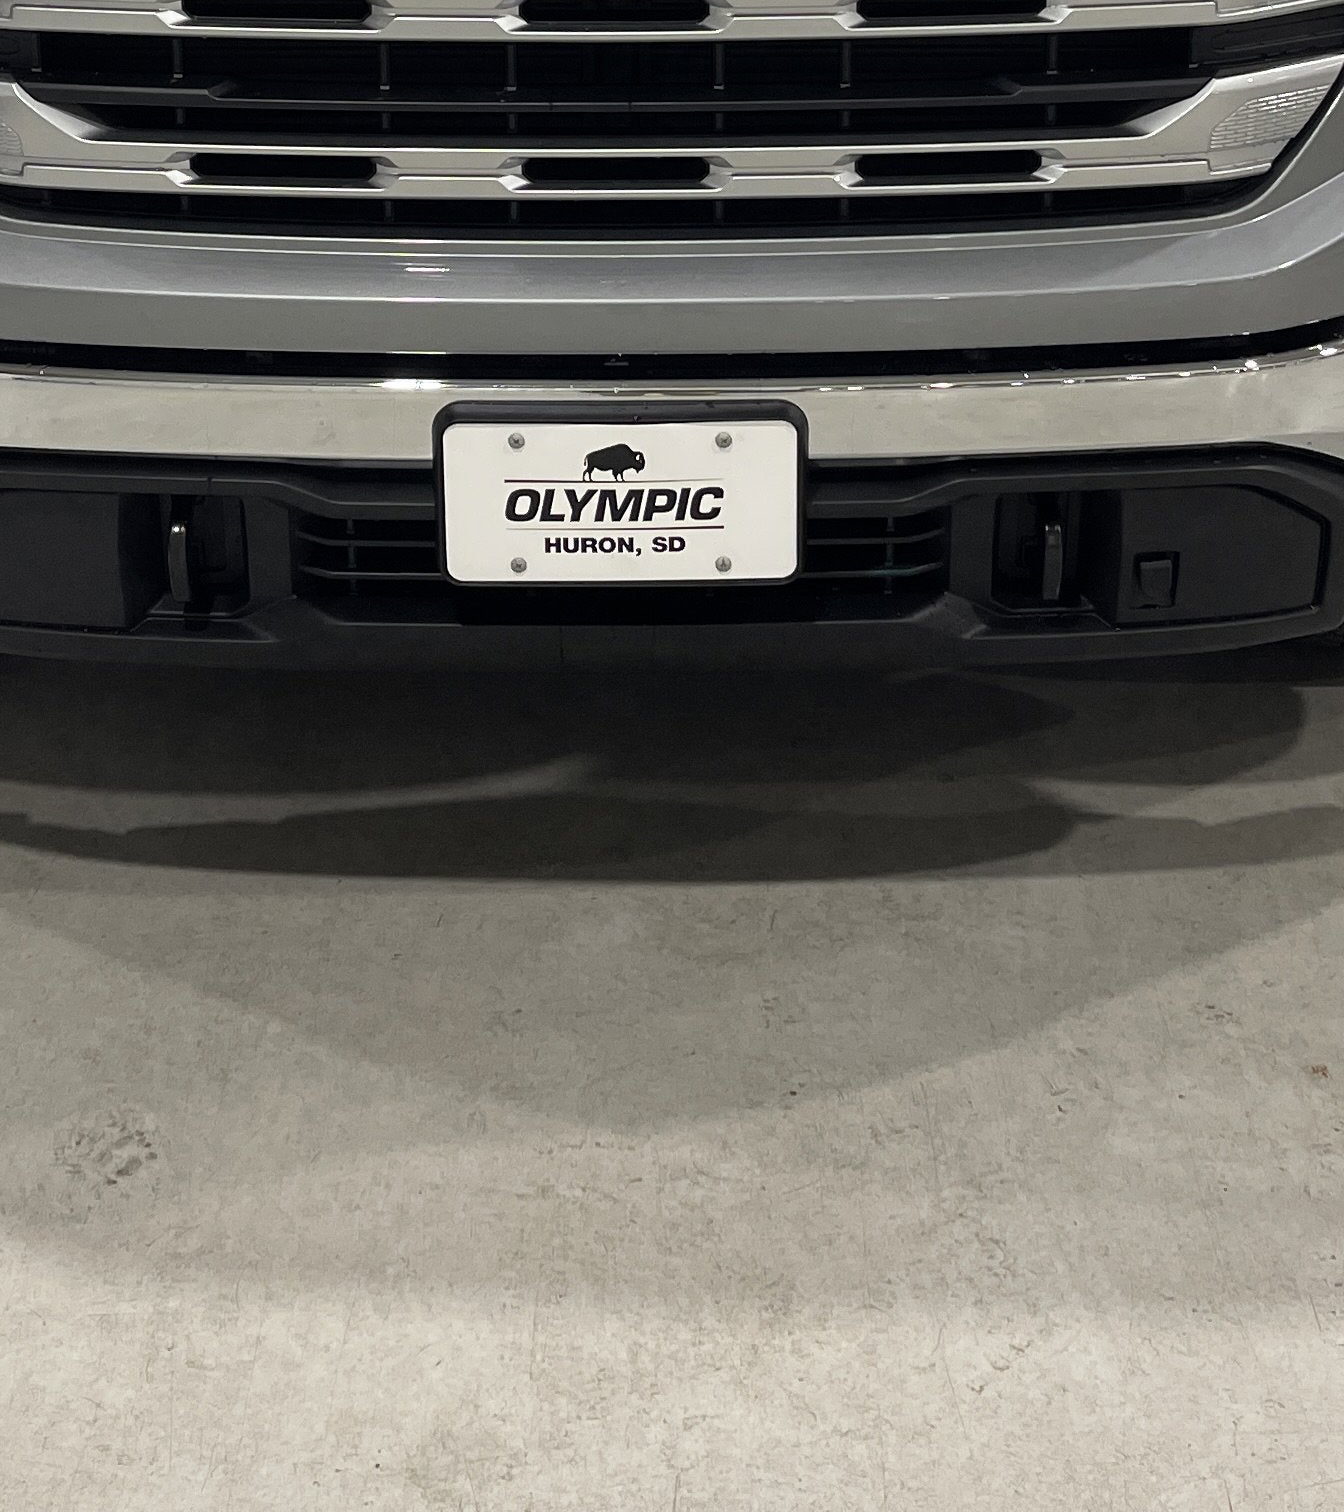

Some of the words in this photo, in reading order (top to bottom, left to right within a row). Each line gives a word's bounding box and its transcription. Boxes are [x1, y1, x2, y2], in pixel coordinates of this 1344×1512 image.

[504, 487, 725, 522] OLYMPIC
[544, 536, 642, 556] HURON,
[651, 536, 686, 554] SD
